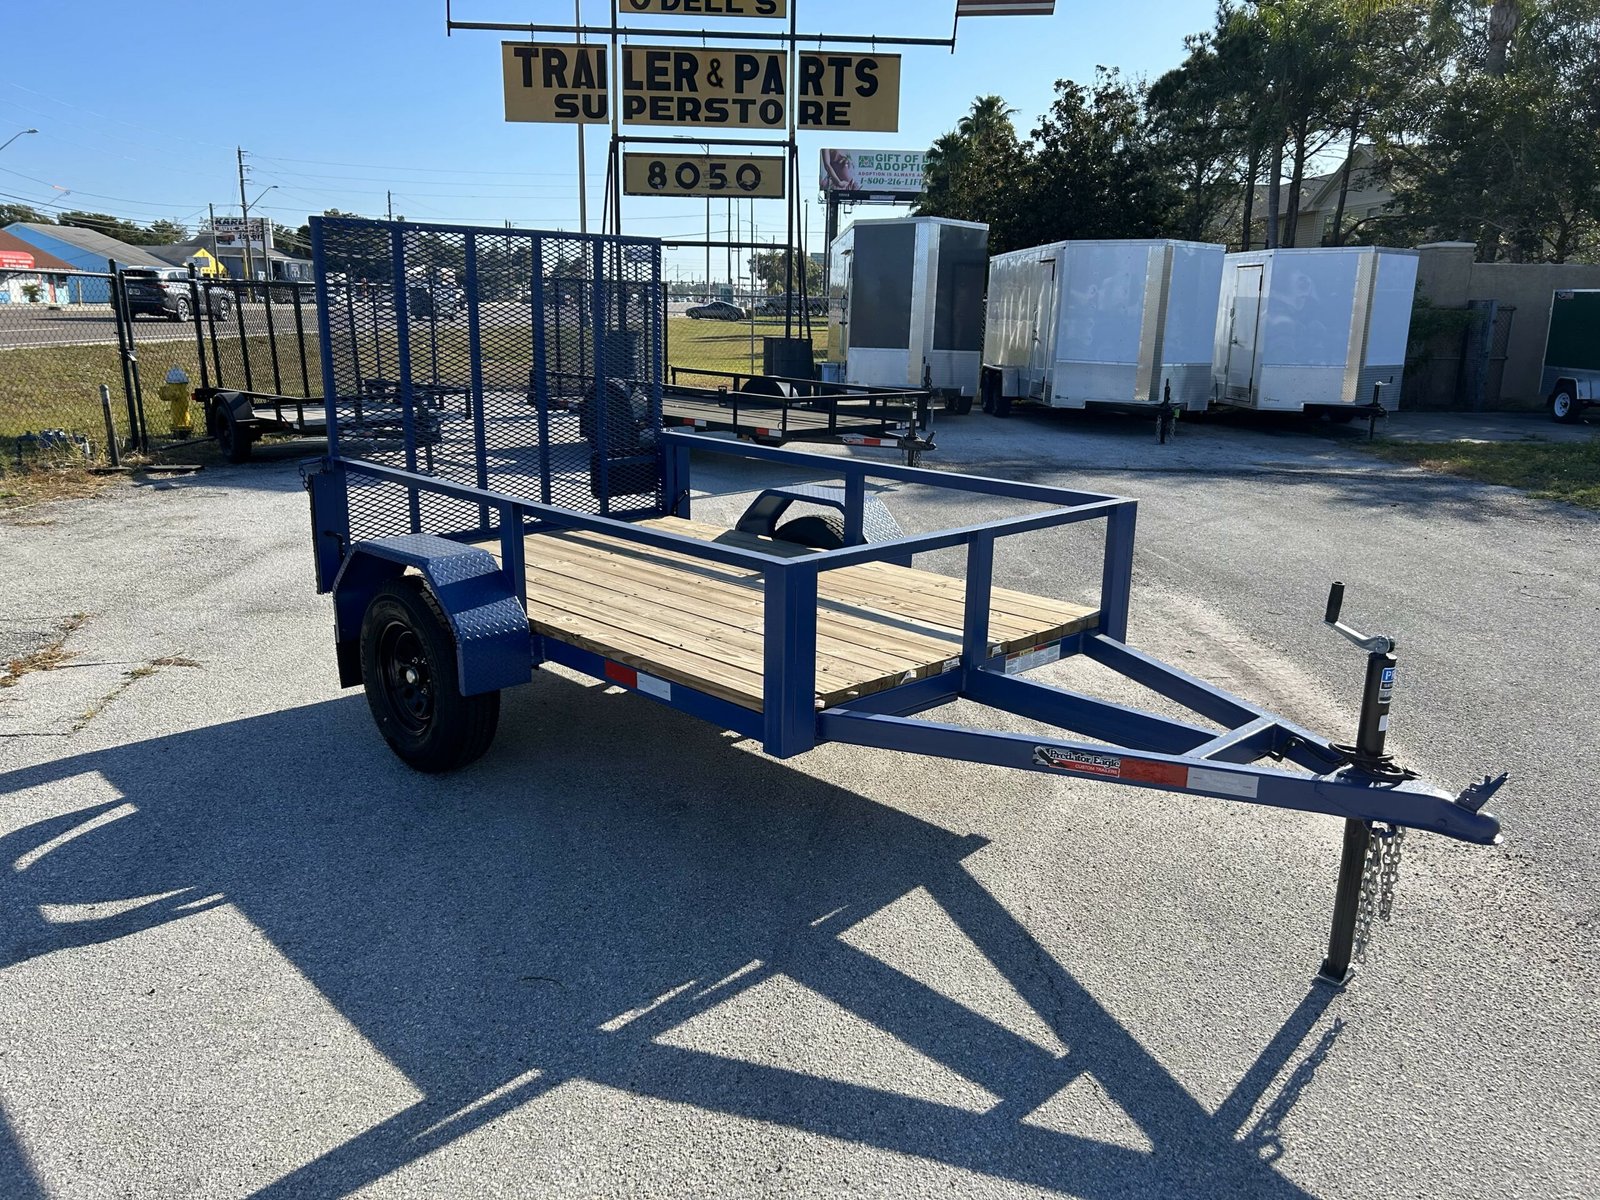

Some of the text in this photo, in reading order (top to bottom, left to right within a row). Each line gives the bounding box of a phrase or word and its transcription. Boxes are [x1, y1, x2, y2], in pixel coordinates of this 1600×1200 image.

[706, 58, 724, 88] &
[735, 54, 879, 97] PARTS
[554, 93, 851, 126] SUPERSTORE
[875, 153, 901, 162] GIFT
[904, 154, 919, 163] OF
[647, 160, 762, 191] 8050
[1049, 749, 1120, 768] Predator Eagle
[1096, 767, 1118, 775] TRAILERS
